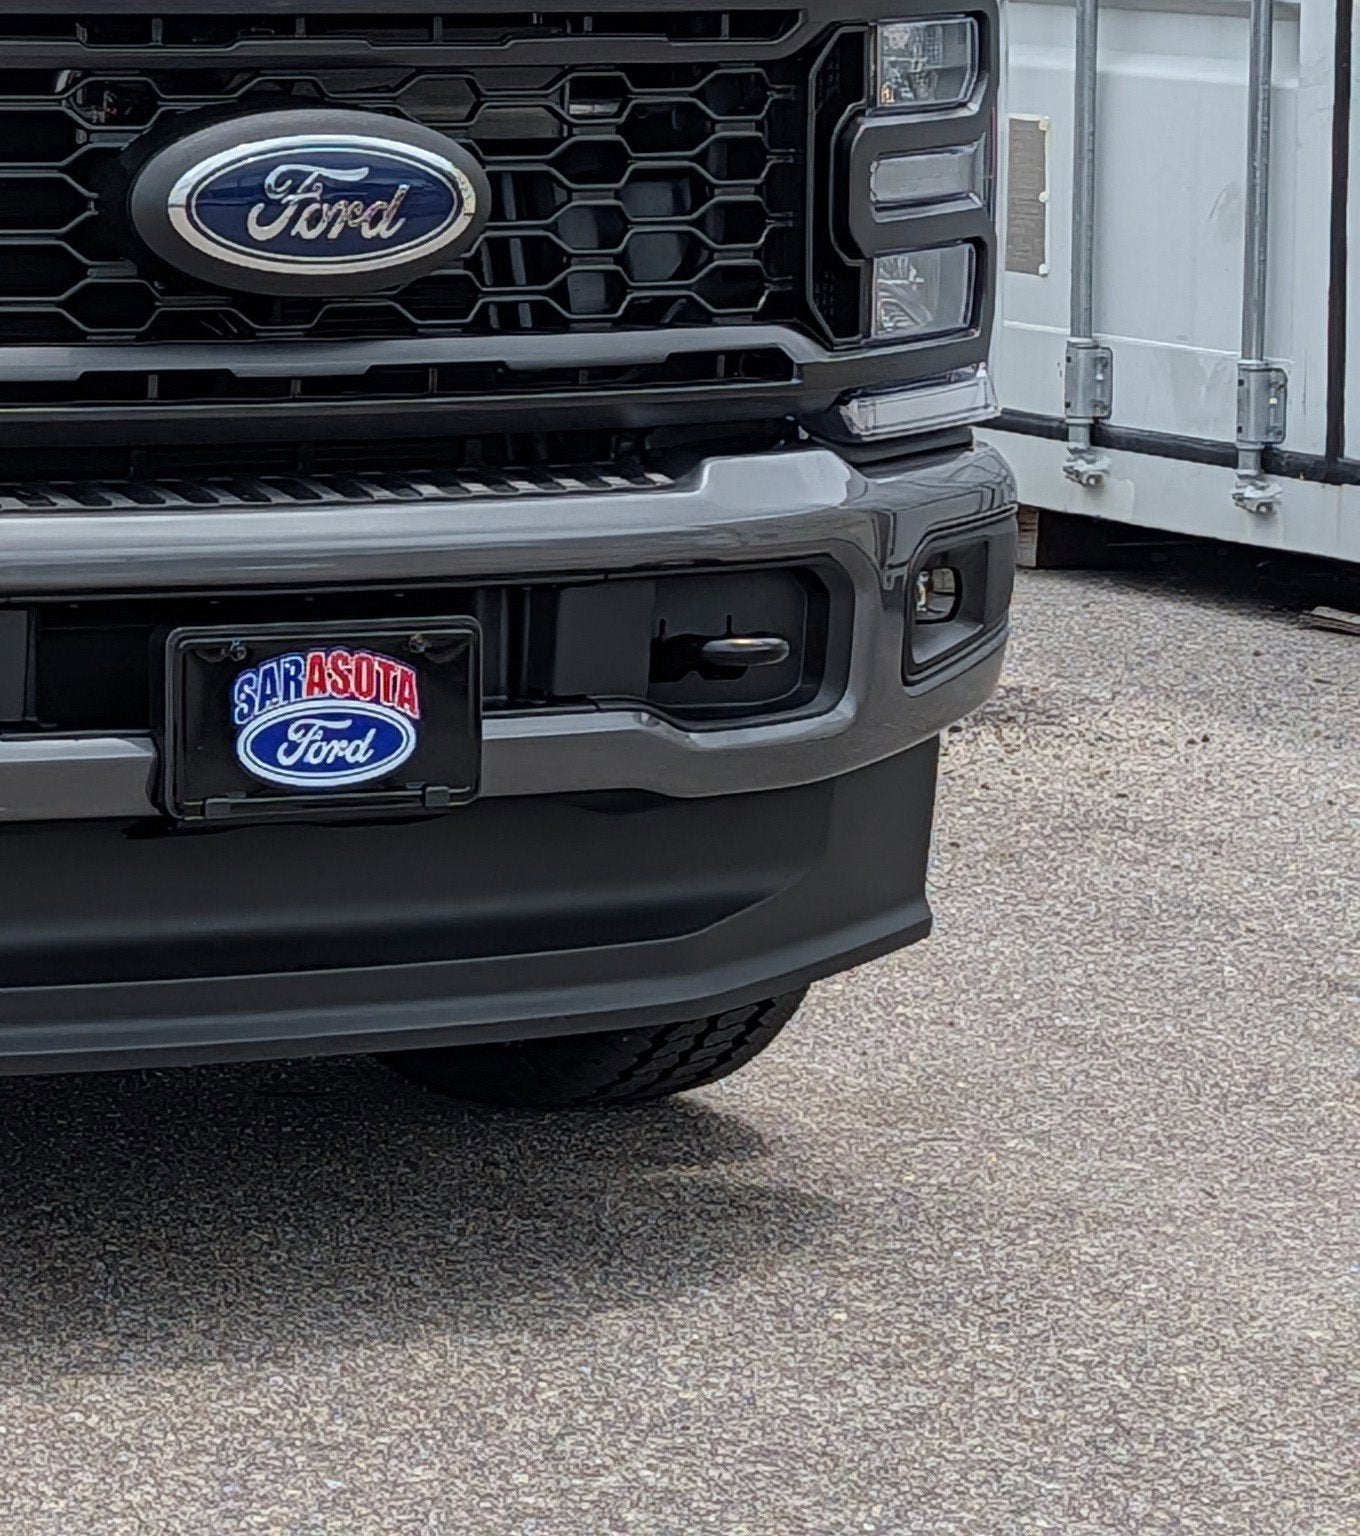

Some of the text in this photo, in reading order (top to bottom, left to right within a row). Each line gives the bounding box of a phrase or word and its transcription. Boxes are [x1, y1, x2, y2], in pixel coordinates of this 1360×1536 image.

[247, 163, 411, 242] Ford
[234, 648, 421, 725] SARASOTA
[277, 717, 378, 766] Ford
